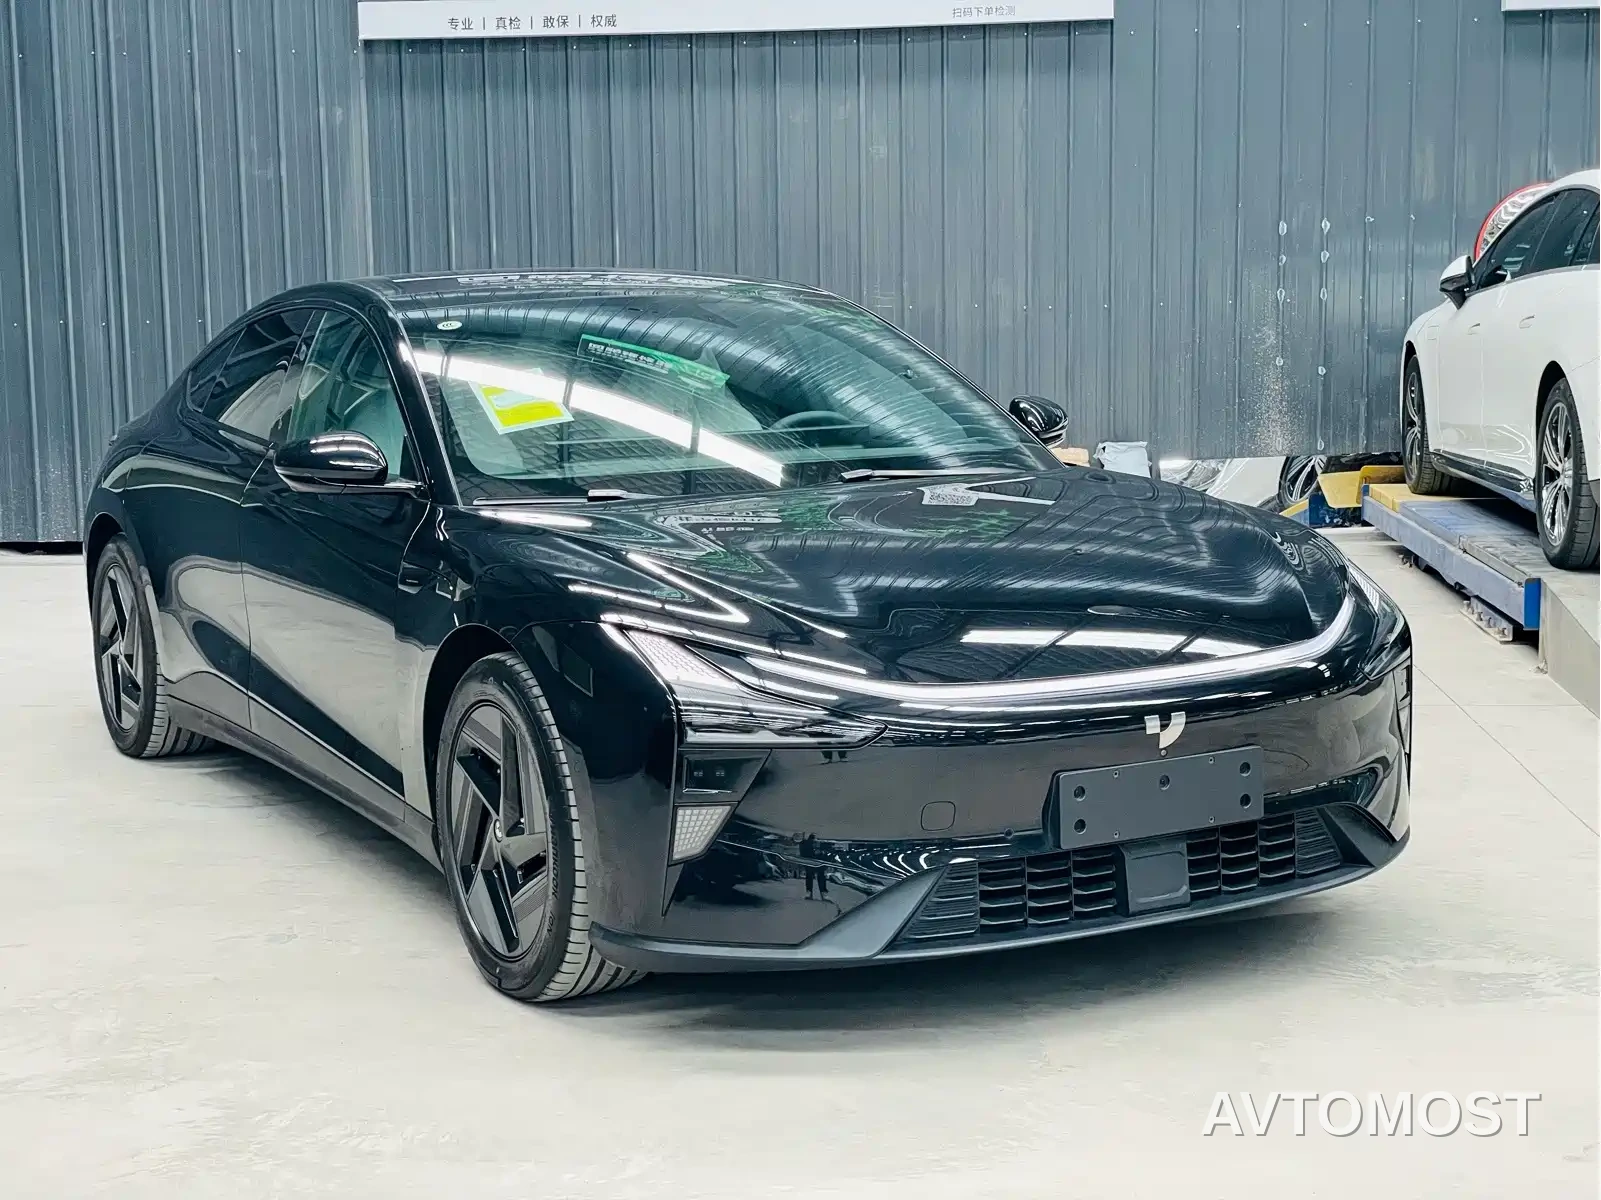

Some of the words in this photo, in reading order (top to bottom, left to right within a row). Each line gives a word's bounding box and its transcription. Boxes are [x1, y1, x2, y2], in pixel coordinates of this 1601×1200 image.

[952, 5, 1016, 18] 扫码下单检测
[448, 17, 473, 30] 专业
[495, 16, 521, 30] 真检
[542, 15, 569, 29] 敢保
[590, 14, 617, 28] 权威
